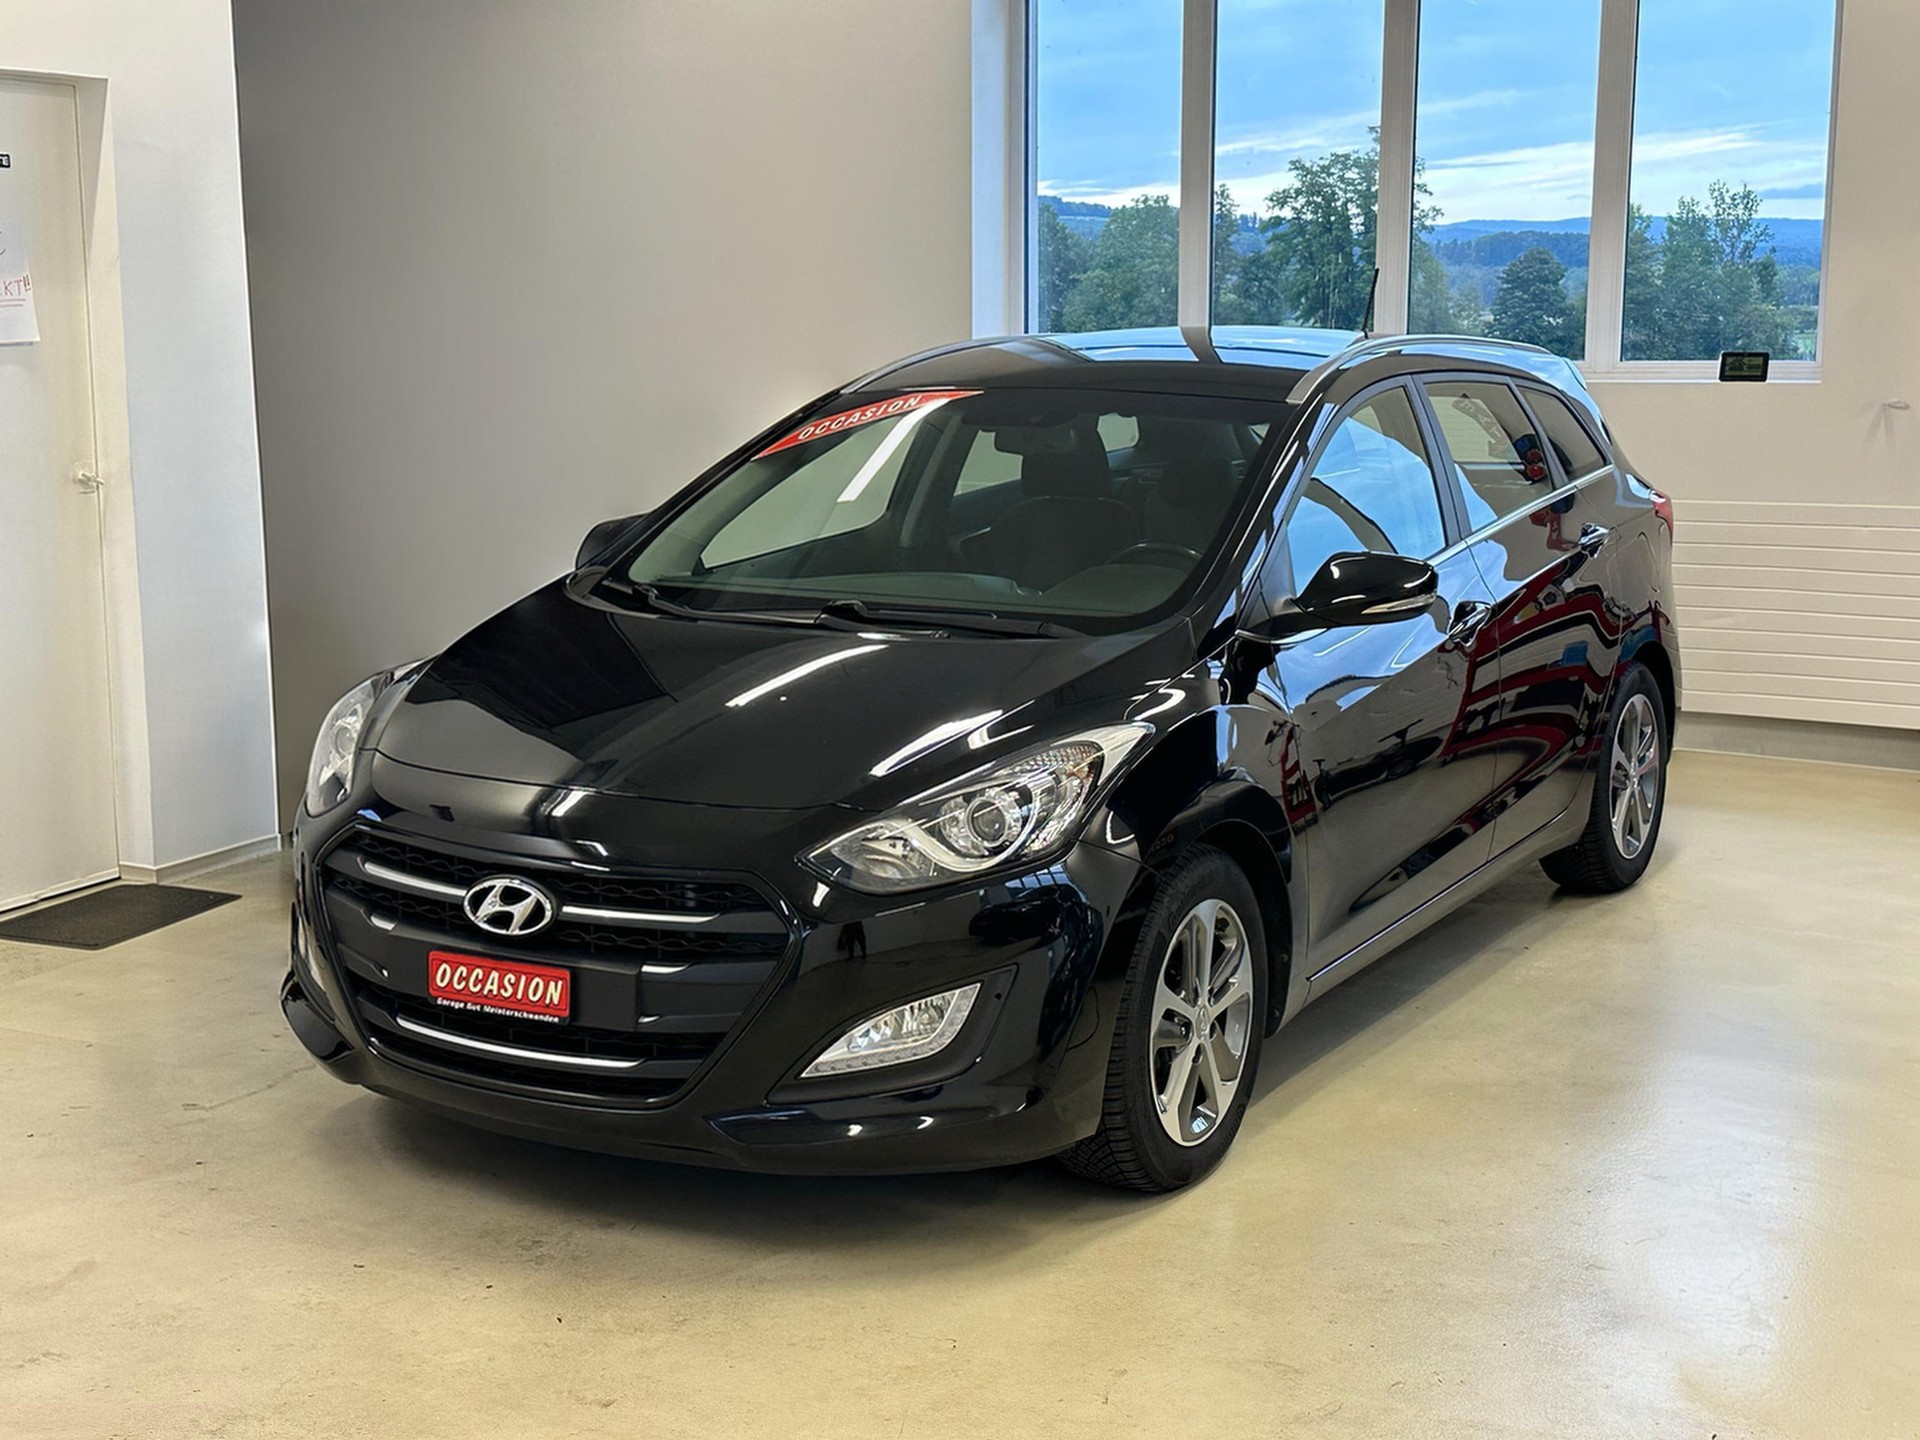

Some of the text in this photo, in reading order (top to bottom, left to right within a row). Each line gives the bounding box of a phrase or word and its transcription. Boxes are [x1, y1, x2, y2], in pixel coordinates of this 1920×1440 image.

[0, 274, 31, 296] KT!!
[798, 395, 923, 440] OCCASION
[435, 962, 563, 1006] OCCASION
[436, 997, 465, 1009] Garage
